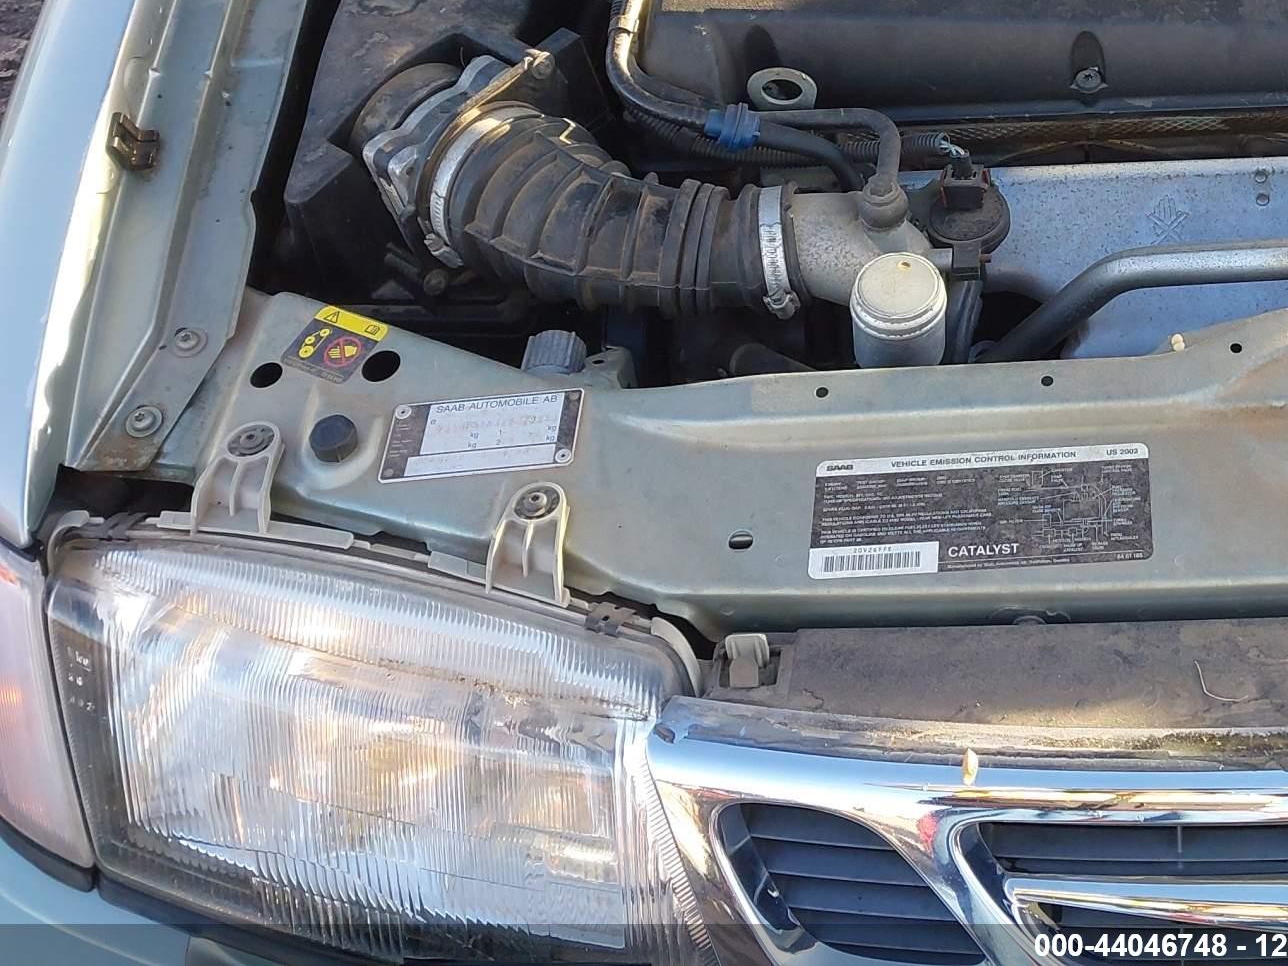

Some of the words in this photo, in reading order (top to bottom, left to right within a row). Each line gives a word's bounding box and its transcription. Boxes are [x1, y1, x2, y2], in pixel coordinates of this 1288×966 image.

[435, 403, 465, 414] SAAB
[468, 396, 538, 410] AUTOMOBILE
[542, 394, 558, 404] AB
[891, 459, 927, 468] VEHICLE
[930, 456, 972, 466] EMISSION
[974, 454, 1014, 464] CONTROL
[1018, 451, 1077, 461] INFORMATION
[826, 464, 854, 472] SAAB
[948, 542, 1020, 558] CATALYST
